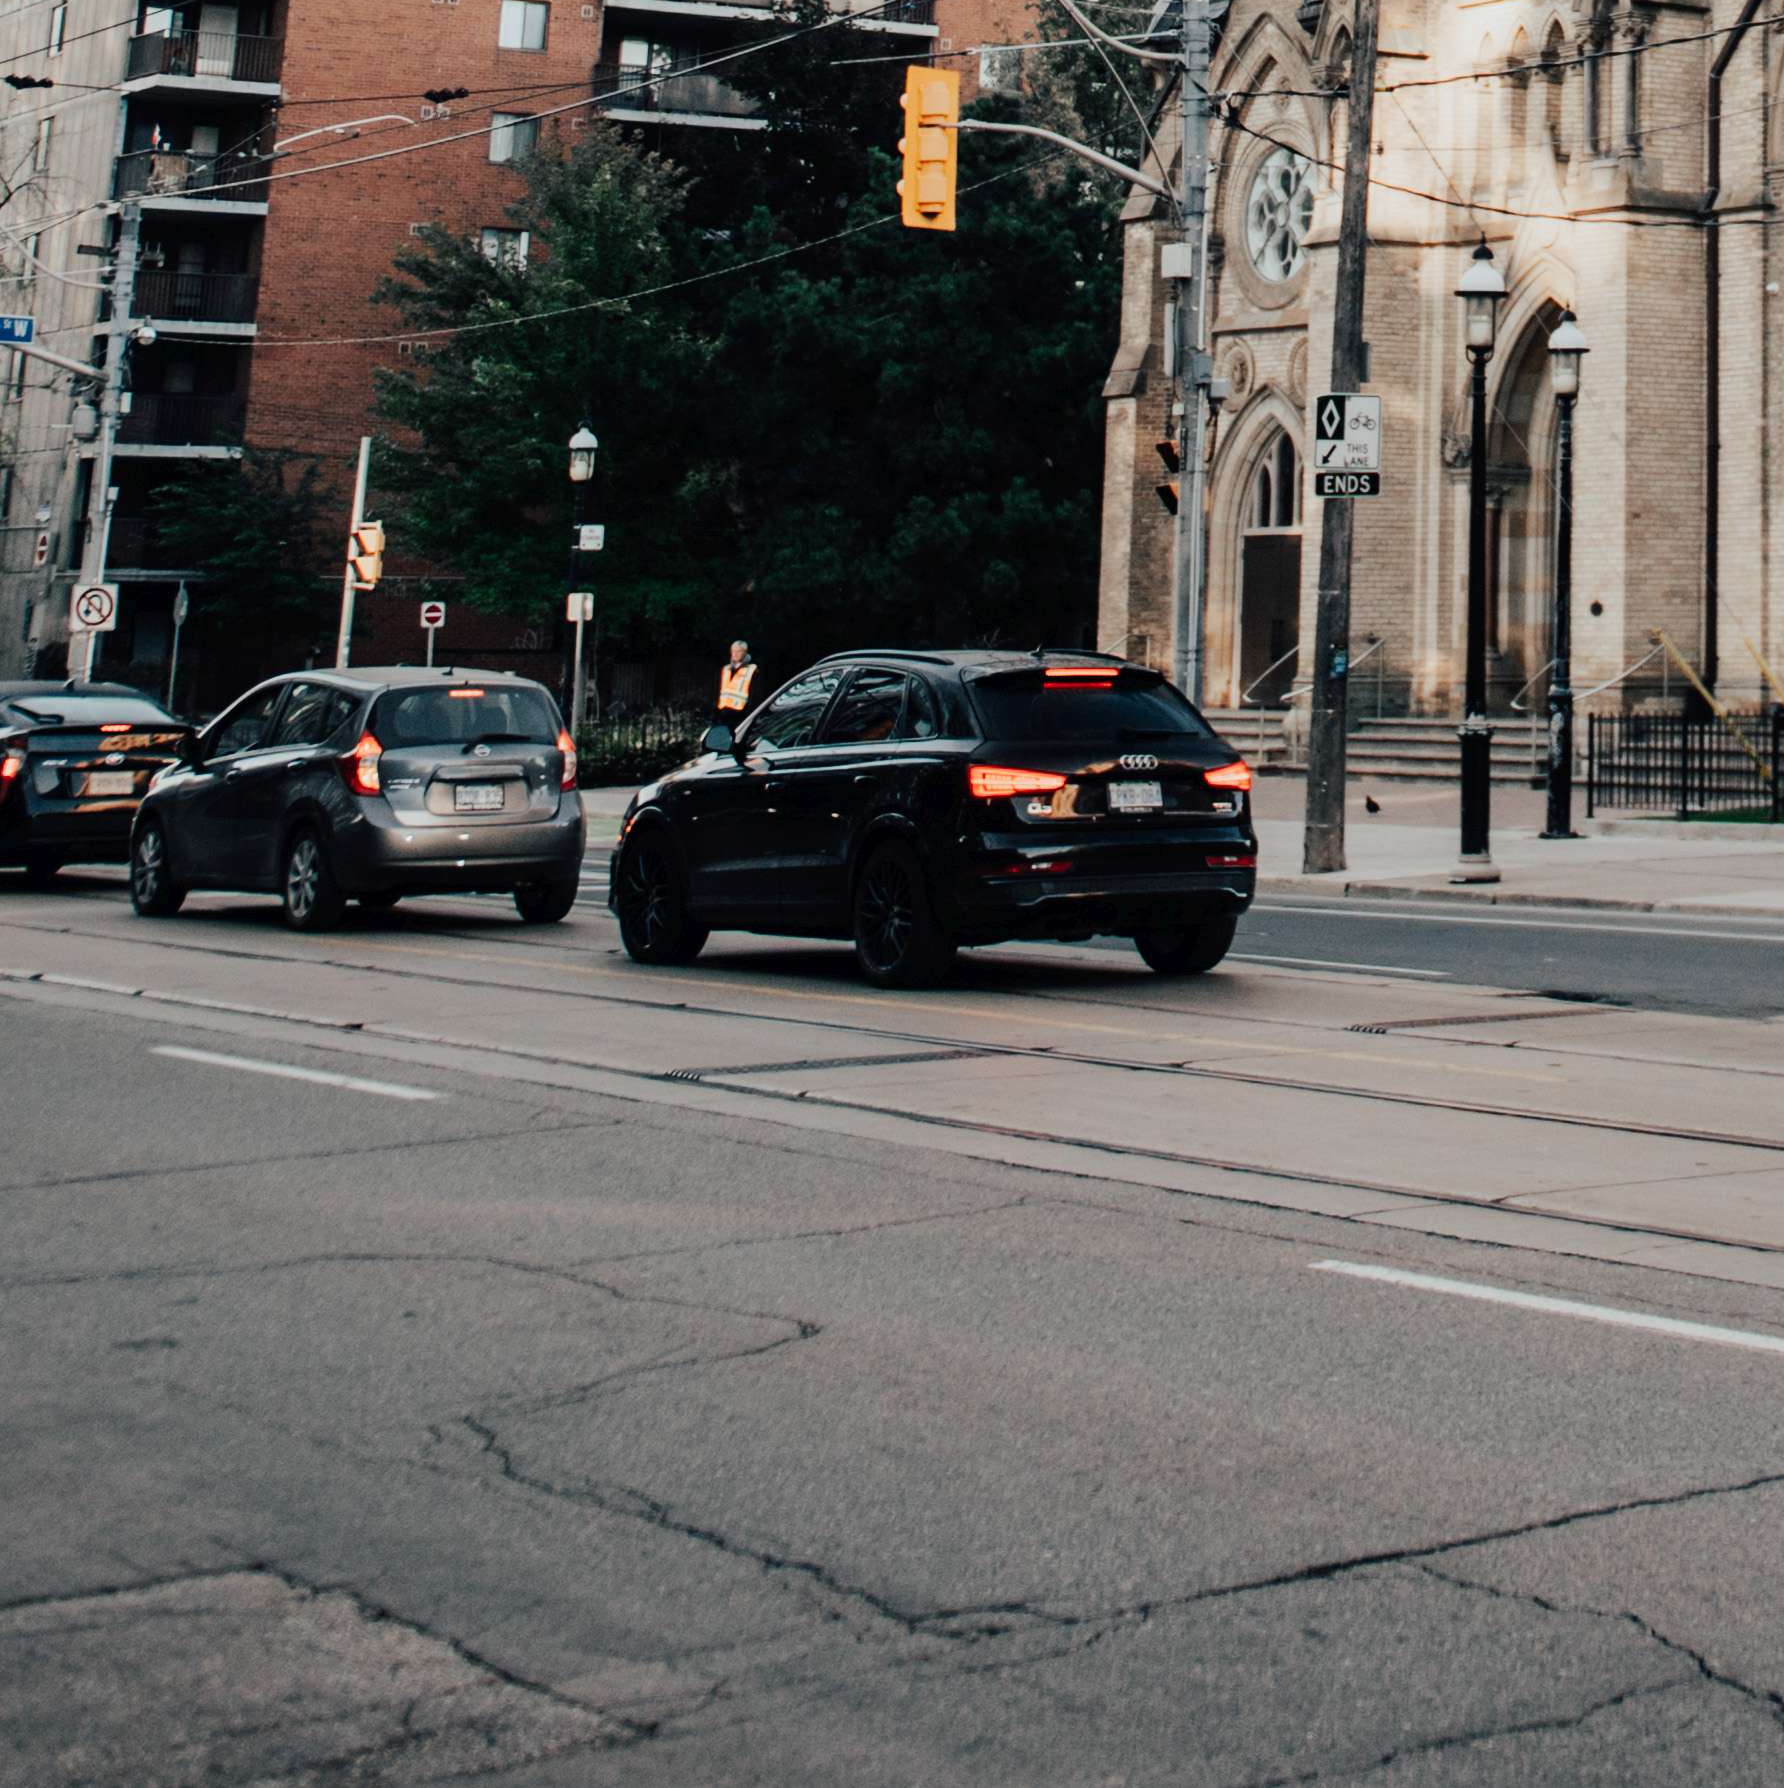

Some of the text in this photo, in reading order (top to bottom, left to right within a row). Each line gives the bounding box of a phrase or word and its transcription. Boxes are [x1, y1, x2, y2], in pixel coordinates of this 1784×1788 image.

[14, 319, 30, 337] W
[1346, 443, 1369, 455] THIS
[1344, 456, 1369, 467] LANE
[1323, 475, 1371, 493] ENDS
